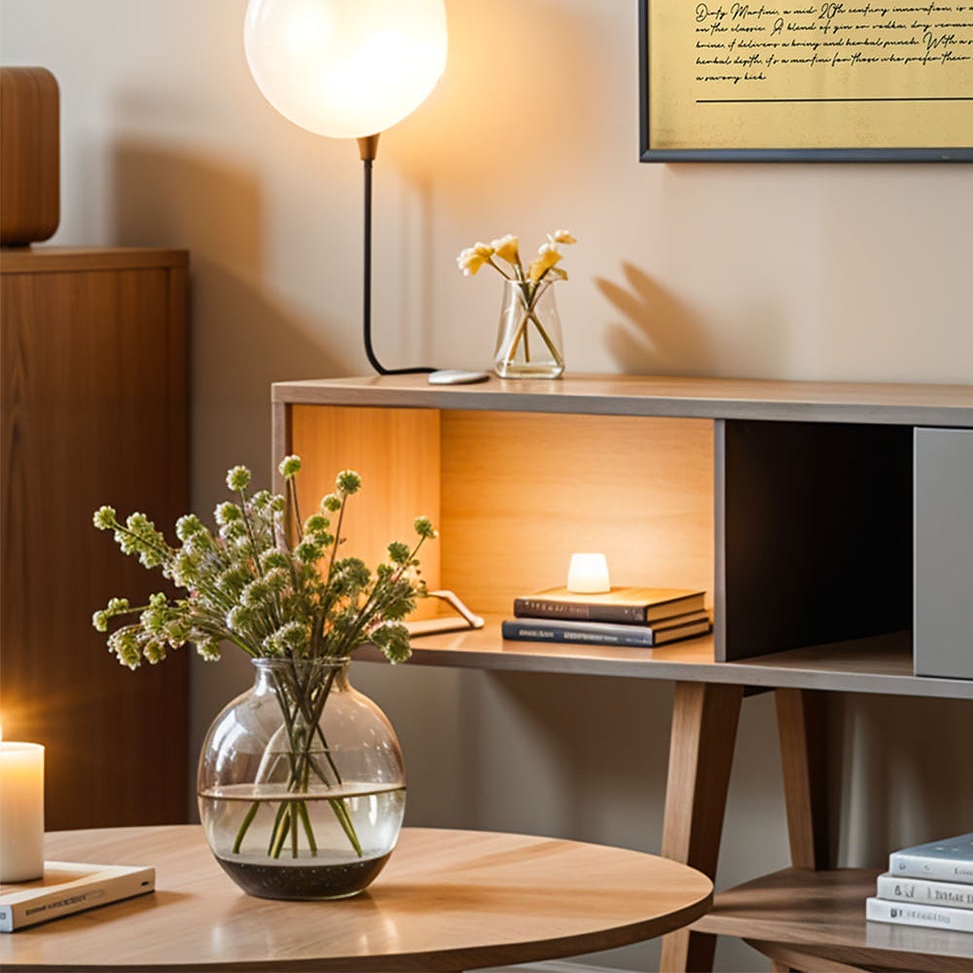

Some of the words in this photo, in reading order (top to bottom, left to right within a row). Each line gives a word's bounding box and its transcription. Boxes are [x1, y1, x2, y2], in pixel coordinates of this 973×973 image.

[695, 3, 728, 23] Dirty
[793, 6, 818, 15] mid
[818, 2, 846, 20] 20th
[848, 3, 890, 17] century
[710, 22, 729, 36] the
[770, 17, 784, 36] A
[787, 22, 817, 31] blend
[819, 19, 831, 35] of
[832, 25, 853, 34] gin
[911, 20, 932, 32] dry
[727, 38, 737, 51] it
[737, 39, 780, 49] delivers
[791, 39, 822, 51] briny
[822, 38, 845, 47] and
[845, 38, 883, 47] herbal
[922, 31, 958, 51] With
[695, 57, 733, 65] herbal
[790, 53, 832, 67] martini
[831, 52, 851, 67] for
[851, 52, 880, 67] those
[881, 54, 905, 63] who
[904, 51, 942, 66] prefer
[941, 51, 972, 65] their
[704, 76, 743, 84] savory
